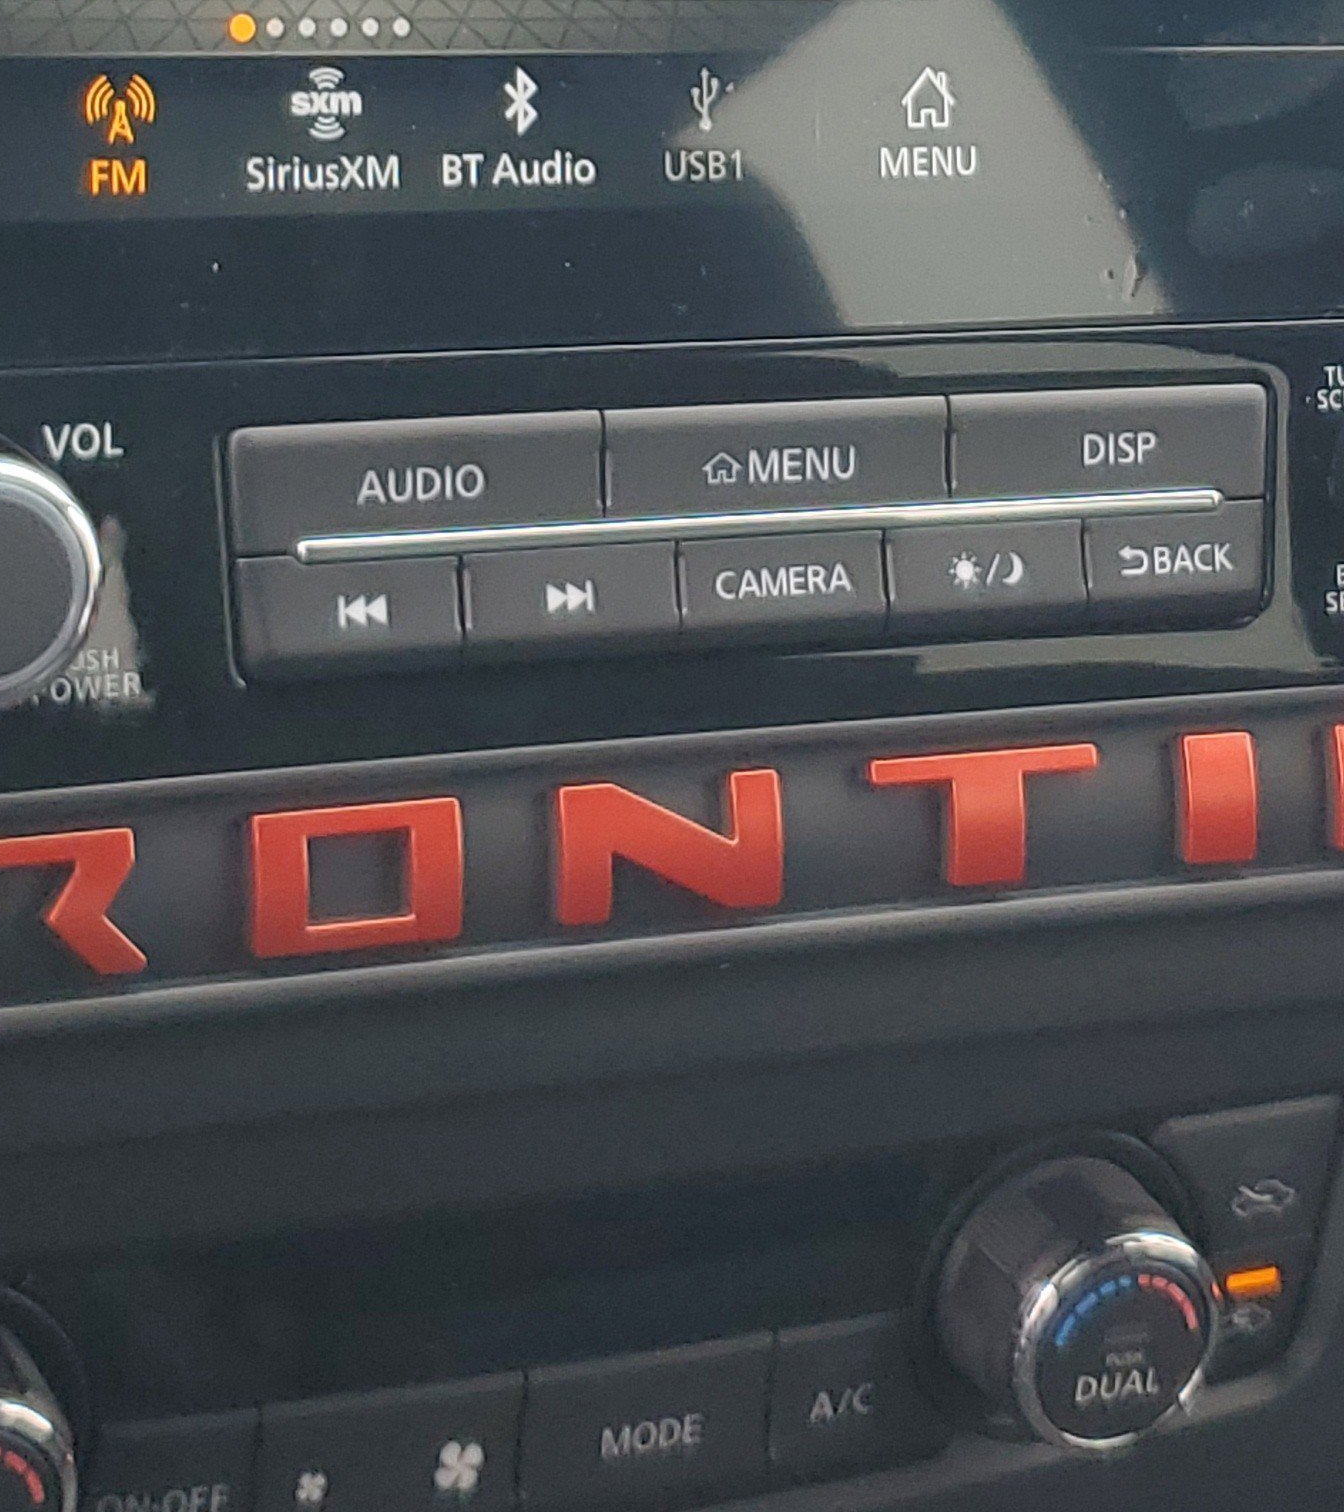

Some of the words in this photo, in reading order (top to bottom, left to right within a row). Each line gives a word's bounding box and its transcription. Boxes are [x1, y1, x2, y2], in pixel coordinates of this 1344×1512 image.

[289, 88, 363, 117] sxm
[89, 159, 148, 195] FM
[246, 153, 401, 191] SiriusXM
[441, 153, 484, 186] BT
[492, 150, 597, 186] Audio
[663, 149, 745, 182] USB1
[879, 145, 978, 179] MENU
[41, 422, 124, 460] VOL
[1082, 430, 1158, 467] DISP
[748, 444, 857, 484] MENU
[357, 463, 485, 505] AUDIO
[1154, 542, 1235, 576] BACK
[714, 562, 853, 600] CAMERA
[68, 646, 120, 670] USH
[33, 670, 143, 707] OWER
[1075, 1366, 1160, 1403] DUAL
[809, 1383, 873, 1425] A/C
[599, 1413, 706, 1460] MODE
